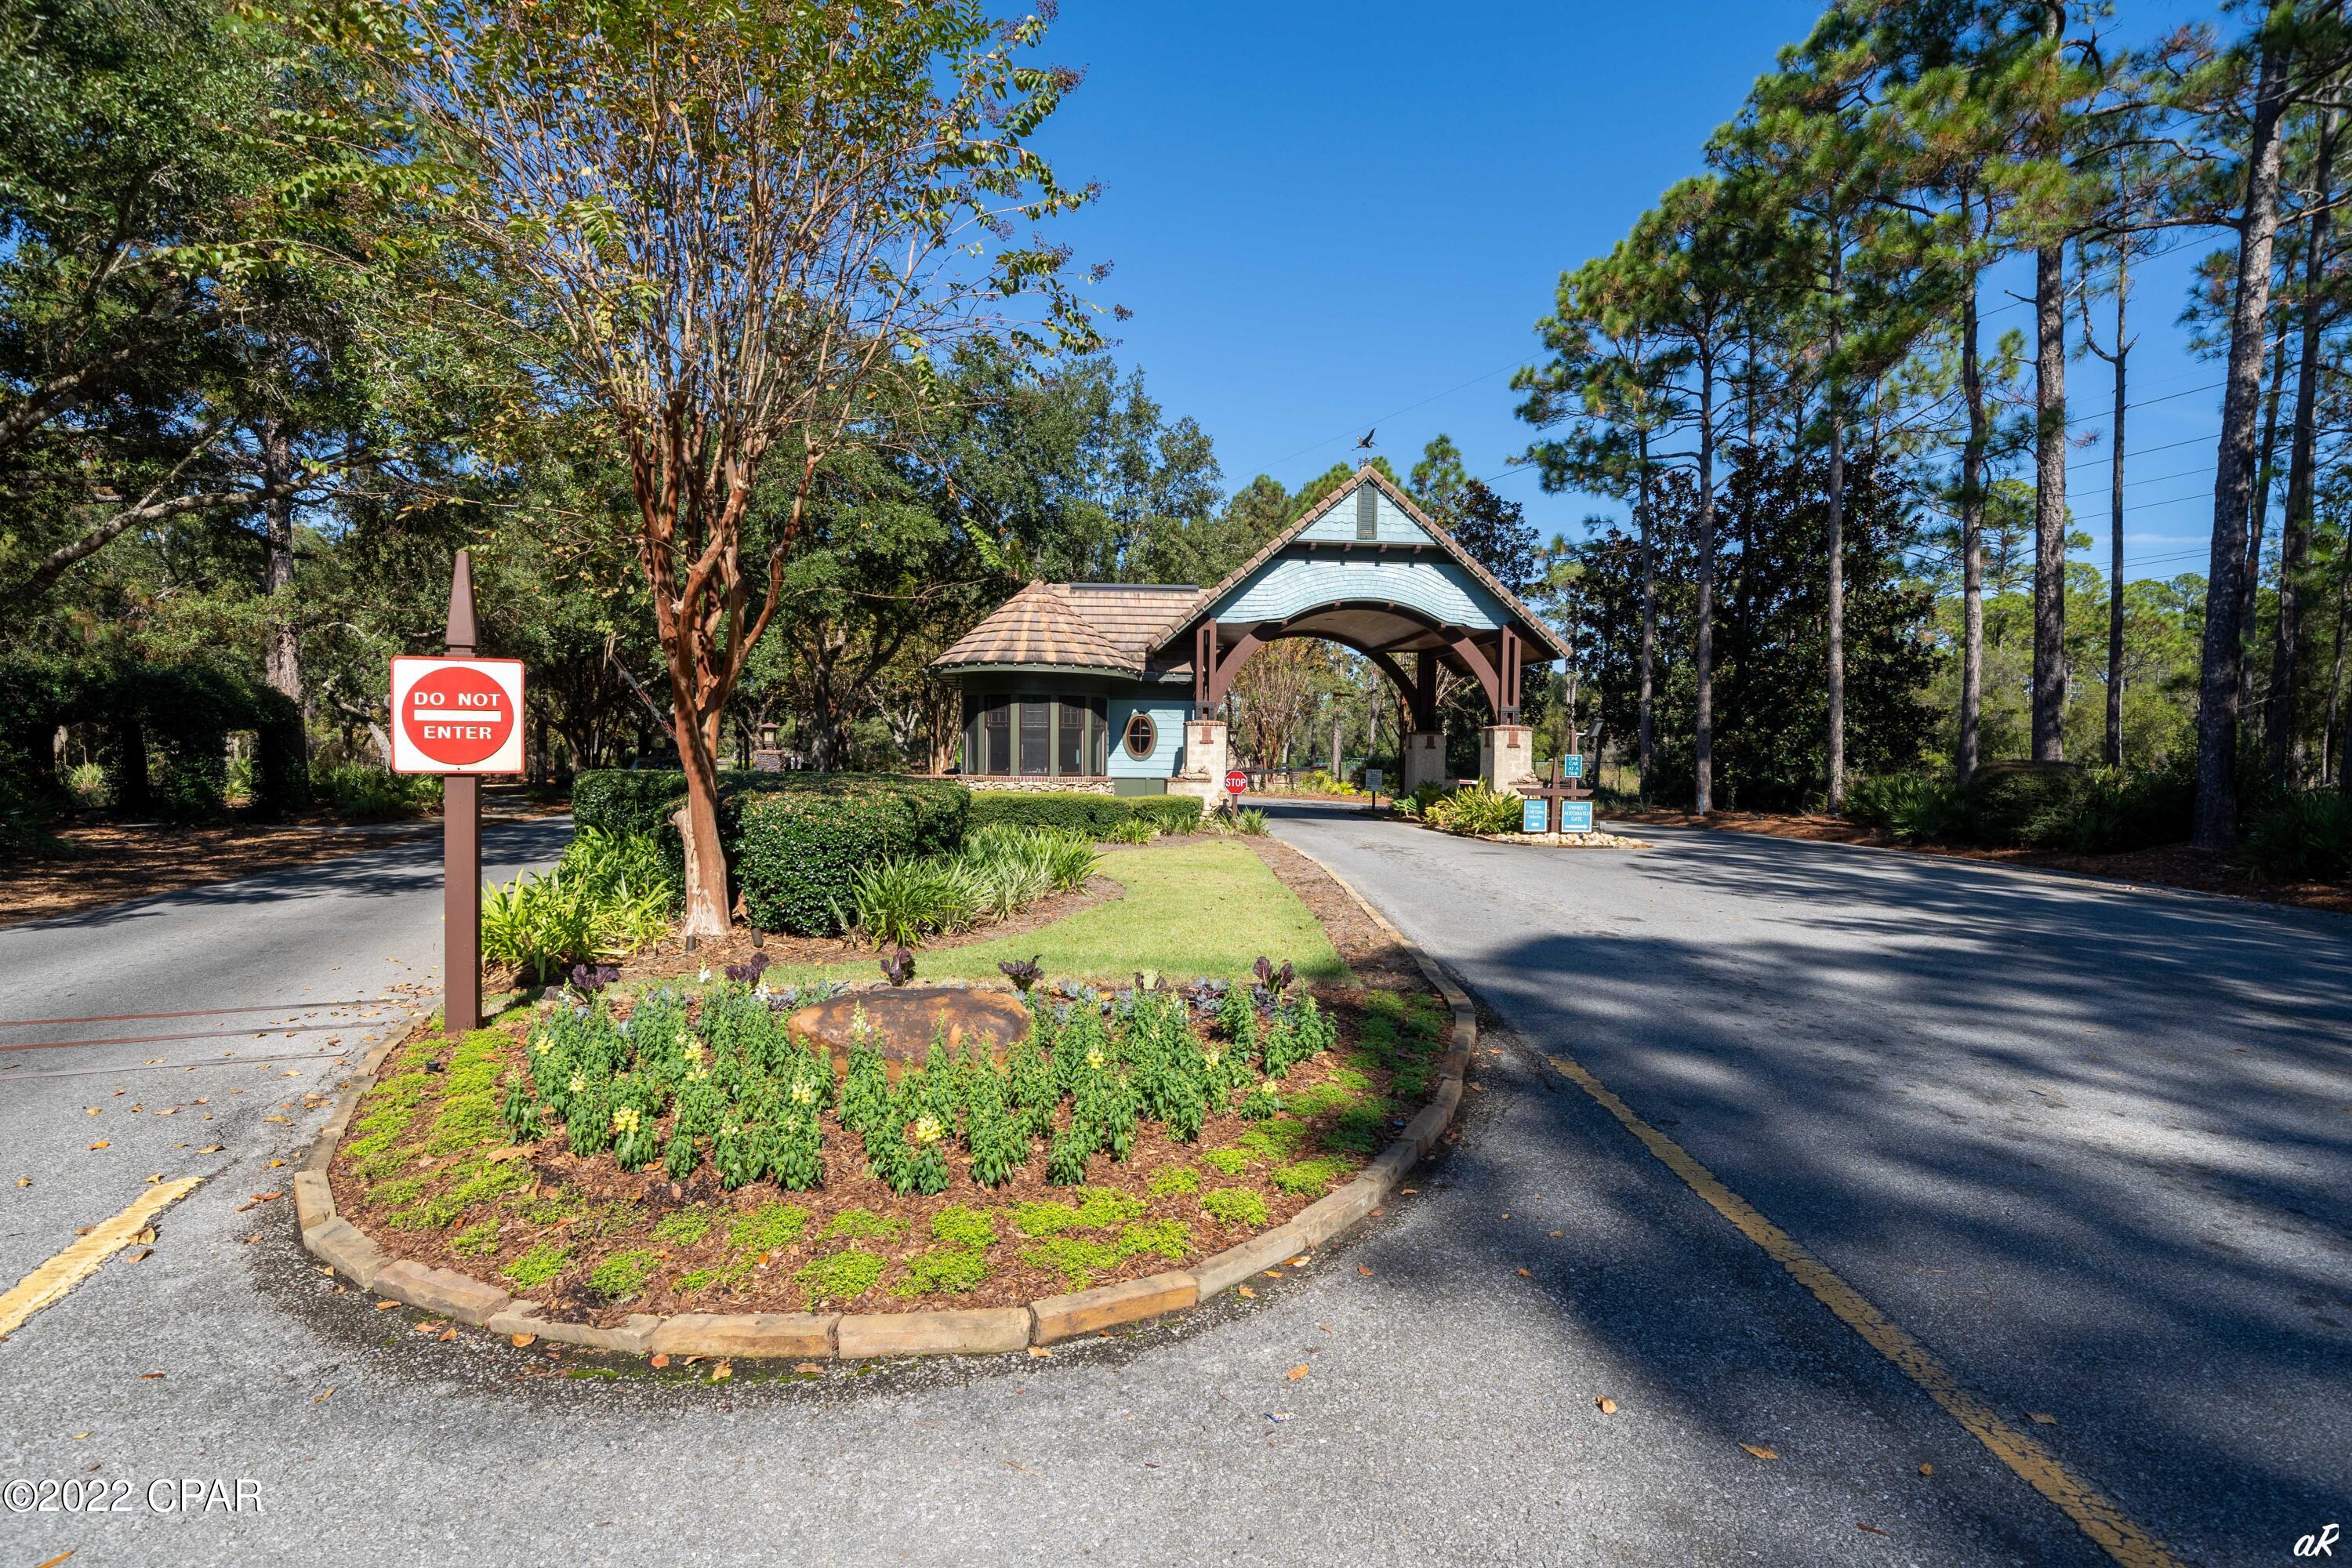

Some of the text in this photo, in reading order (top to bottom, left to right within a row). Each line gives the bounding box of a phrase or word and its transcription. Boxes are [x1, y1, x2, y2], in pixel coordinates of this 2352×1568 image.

[414, 691, 501, 706] DO NOT
[423, 725, 492, 739] ENTER
[1225, 778, 1246, 787] STOP
